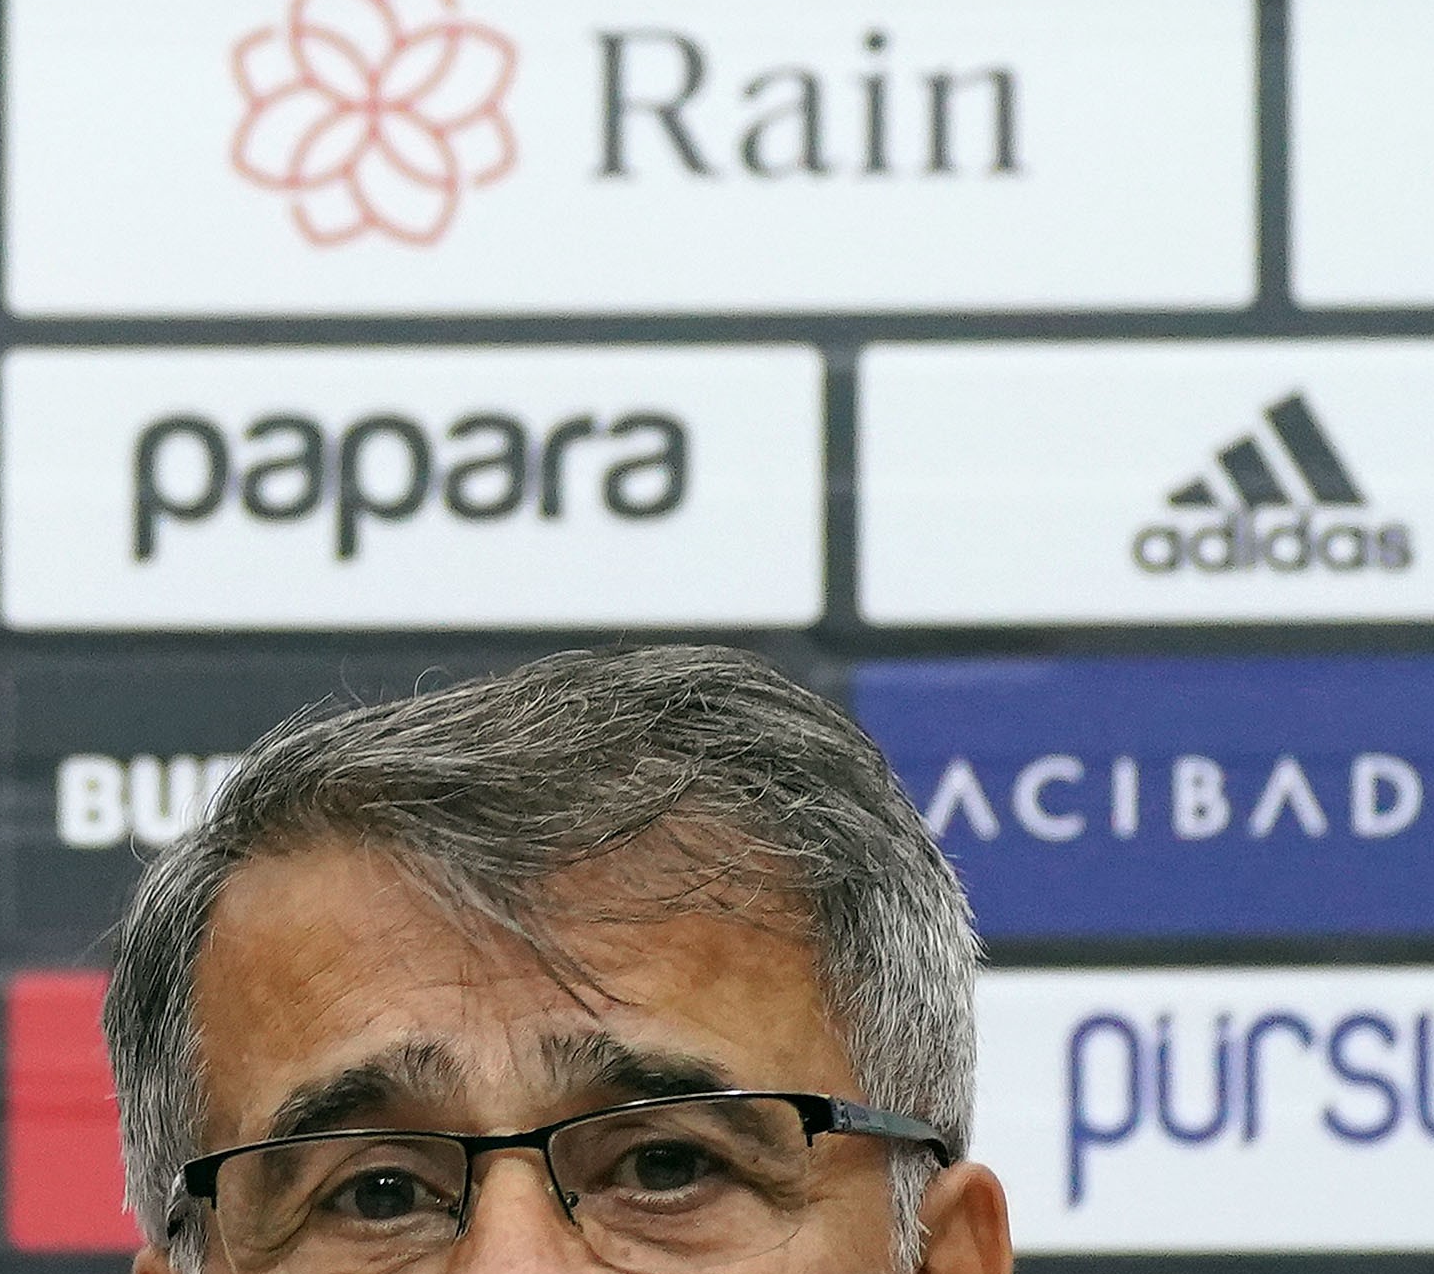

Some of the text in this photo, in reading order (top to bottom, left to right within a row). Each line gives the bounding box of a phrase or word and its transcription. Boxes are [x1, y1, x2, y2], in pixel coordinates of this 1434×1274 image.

[597, 29, 1020, 180] Rain
[131, 409, 691, 565] papara
[1130, 511, 1416, 577] adidas
